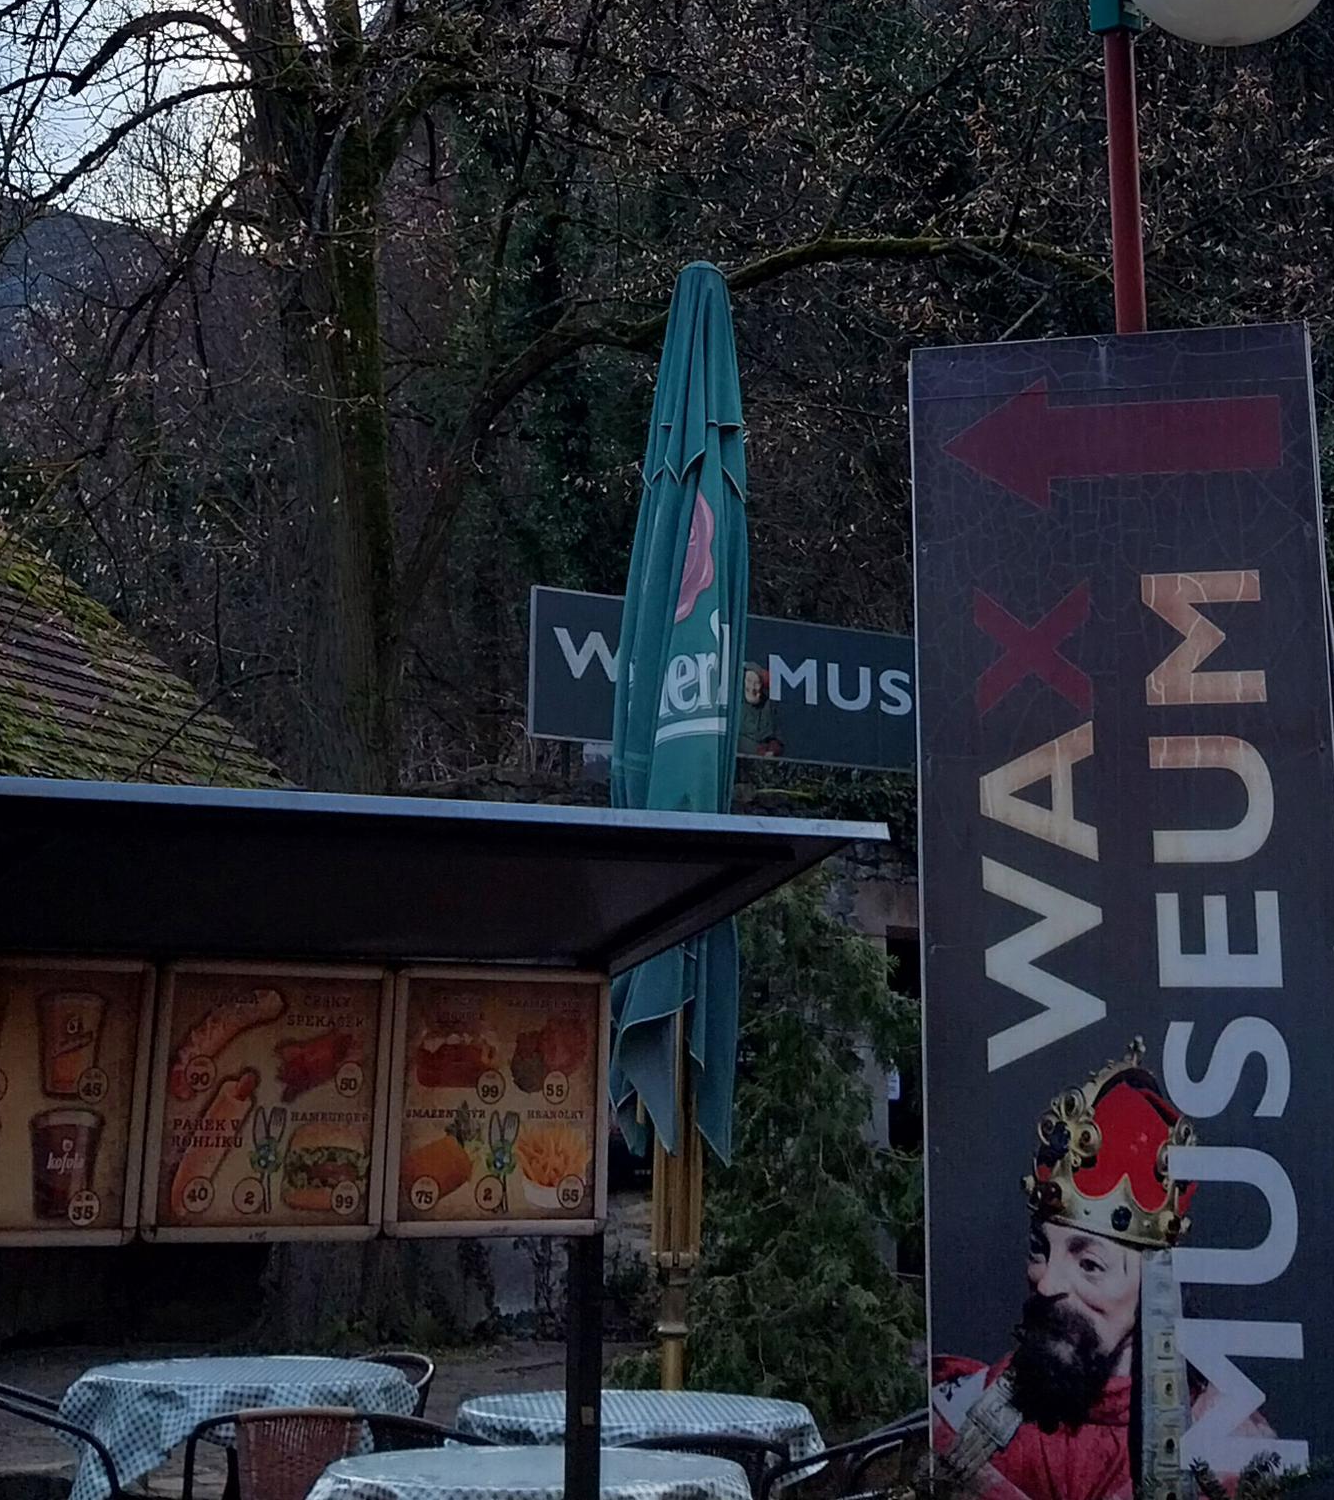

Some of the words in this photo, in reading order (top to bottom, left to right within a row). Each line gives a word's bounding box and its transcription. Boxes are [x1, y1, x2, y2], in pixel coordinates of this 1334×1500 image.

[972, 578, 1108, 1071] WAX
[1140, 568, 1310, 1476] MUSEUM
[190, 1072, 210, 1086] 90
[339, 1077, 358, 1091] 50
[481, 1084, 499, 1098] 99
[186, 1187, 208, 1202] 40
[243, 1191, 255, 1205] 2
[335, 1194, 354, 1208] 99
[483, 1188, 493, 1201] 2
